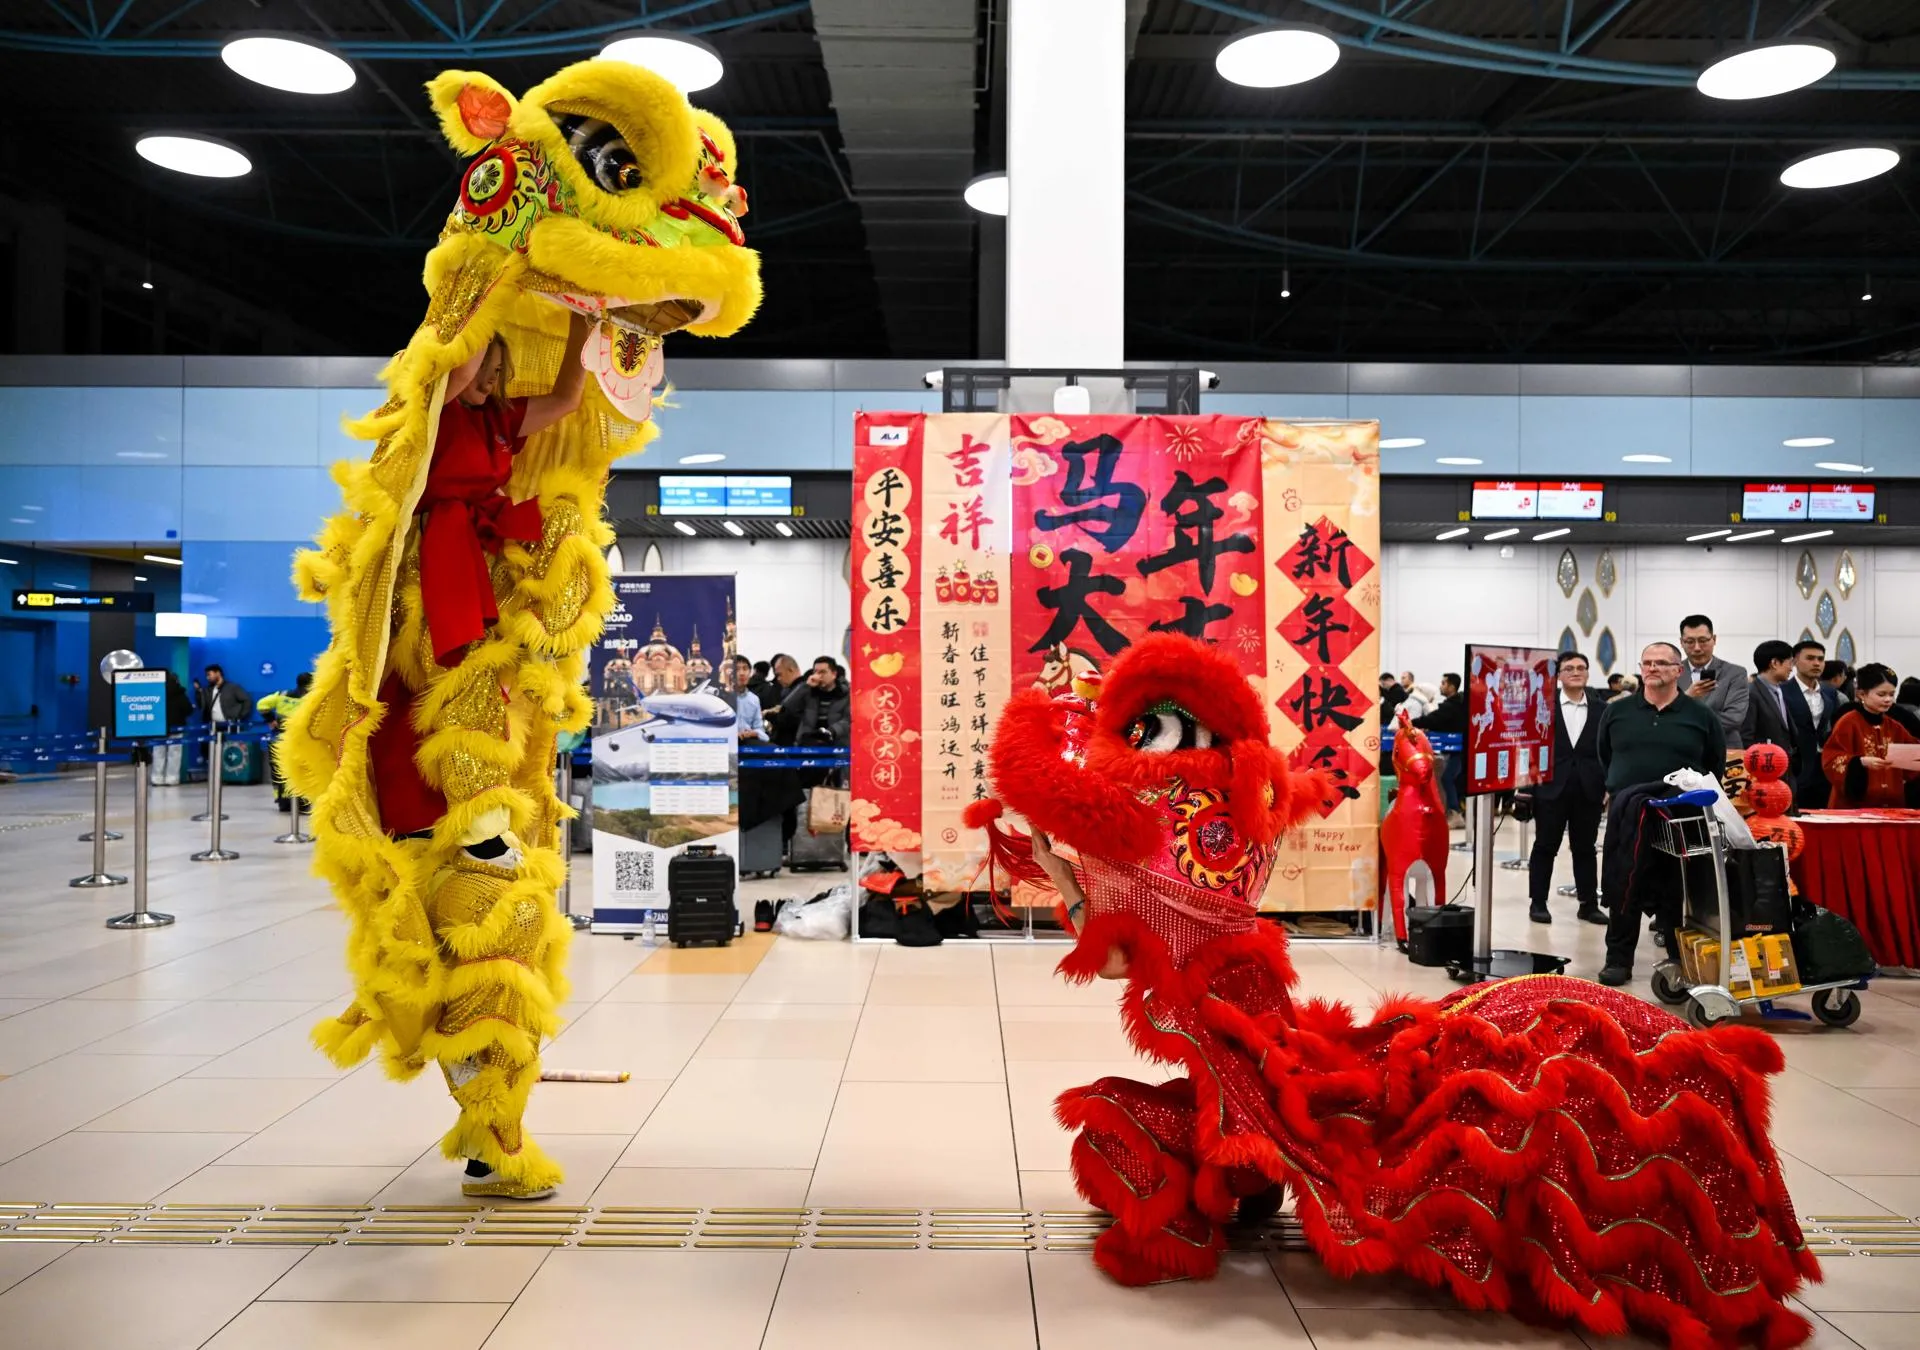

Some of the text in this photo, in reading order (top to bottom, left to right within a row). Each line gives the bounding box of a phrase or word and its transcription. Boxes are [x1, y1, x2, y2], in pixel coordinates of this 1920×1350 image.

[880, 433, 900, 441] ALA
[938, 433, 995, 551] 吉祥
[1730, 512, 1741, 524] 10
[1878, 514, 1888, 525] 11
[868, 468, 908, 632] 平安喜乐
[120, 695, 161, 704] Economy
[128, 702, 153, 711] Class
[873, 690, 897, 786] 大吉大利
[1313, 829, 1345, 841] Happy
[1313, 842, 1362, 852] New Year
